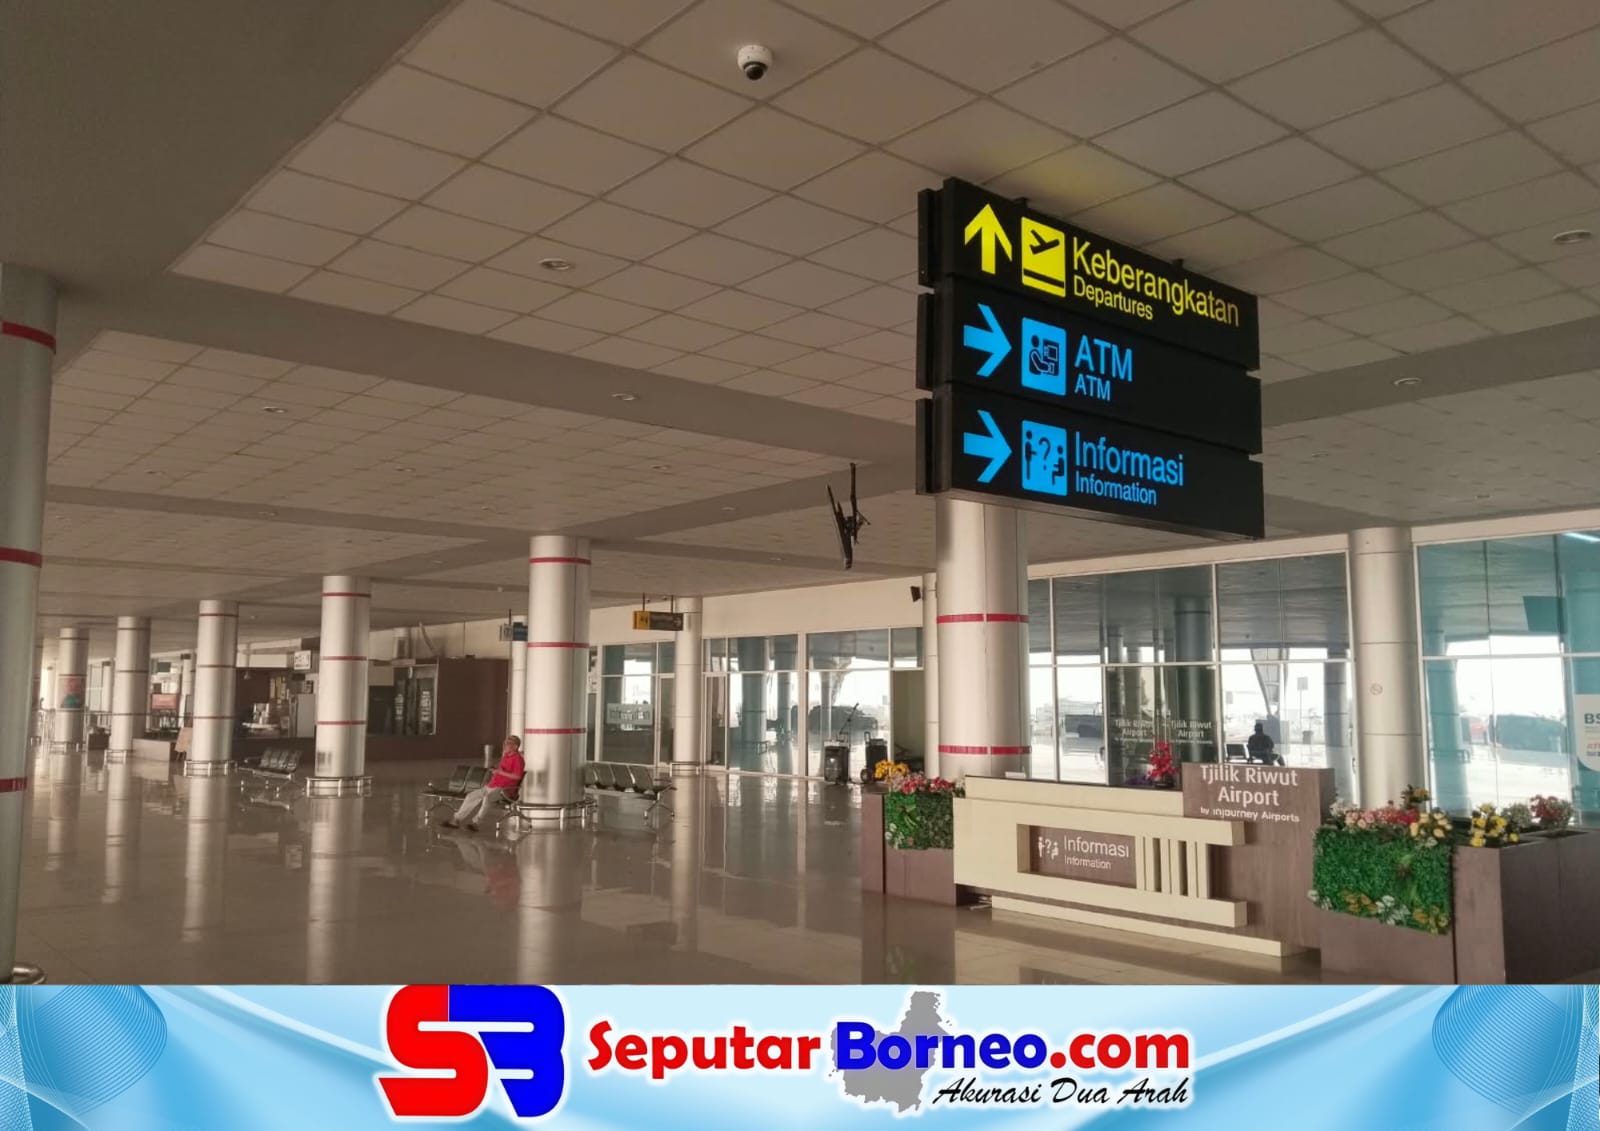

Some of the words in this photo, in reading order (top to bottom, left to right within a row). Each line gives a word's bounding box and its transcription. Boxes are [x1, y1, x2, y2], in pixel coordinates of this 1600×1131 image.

[1072, 236, 1240, 327] Keberangkatan
[1073, 277, 1154, 320] Departures
[1074, 335, 1133, 382] ATM
[1074, 375, 1111, 401] ATM
[1075, 431, 1184, 486] Informasi
[1075, 474, 1157, 505] Information
[1200, 764, 1240, 784] Tjilik
[1245, 767, 1298, 786] Riwut
[1217, 786, 1280, 808] Airport
[1200, 806, 1210, 815] by
[1261, 811, 1300, 822] Airports
[1064, 835, 1129, 858] Informasi
[1064, 855, 1112, 870] Information
